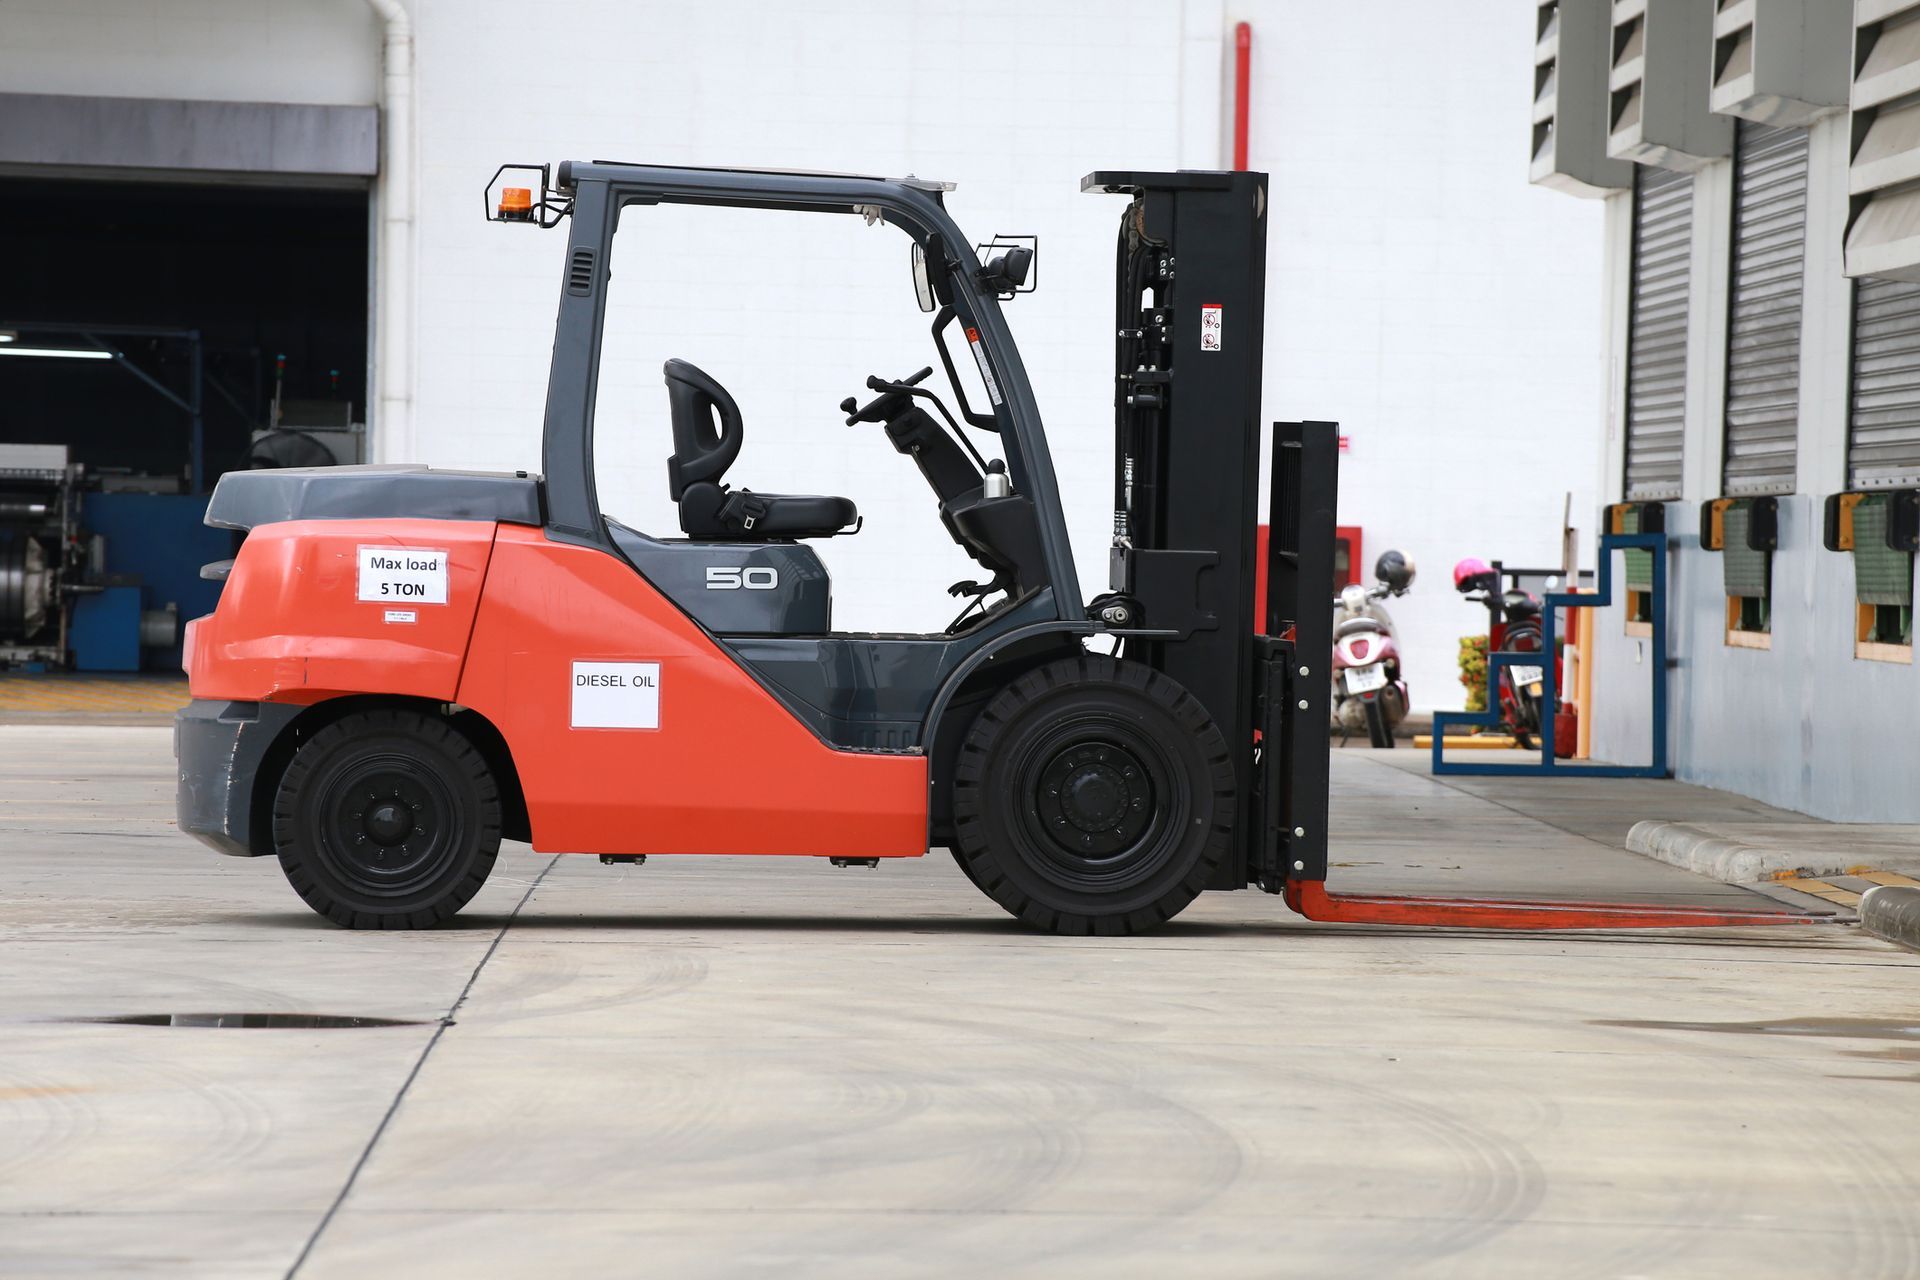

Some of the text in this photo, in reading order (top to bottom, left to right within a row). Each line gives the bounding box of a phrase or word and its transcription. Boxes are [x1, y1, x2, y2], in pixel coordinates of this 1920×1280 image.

[371, 557, 437, 571] Max load
[706, 567, 779, 589] 50
[381, 583, 425, 596] 5 TON
[576, 675, 656, 688] DIESEL OIL
